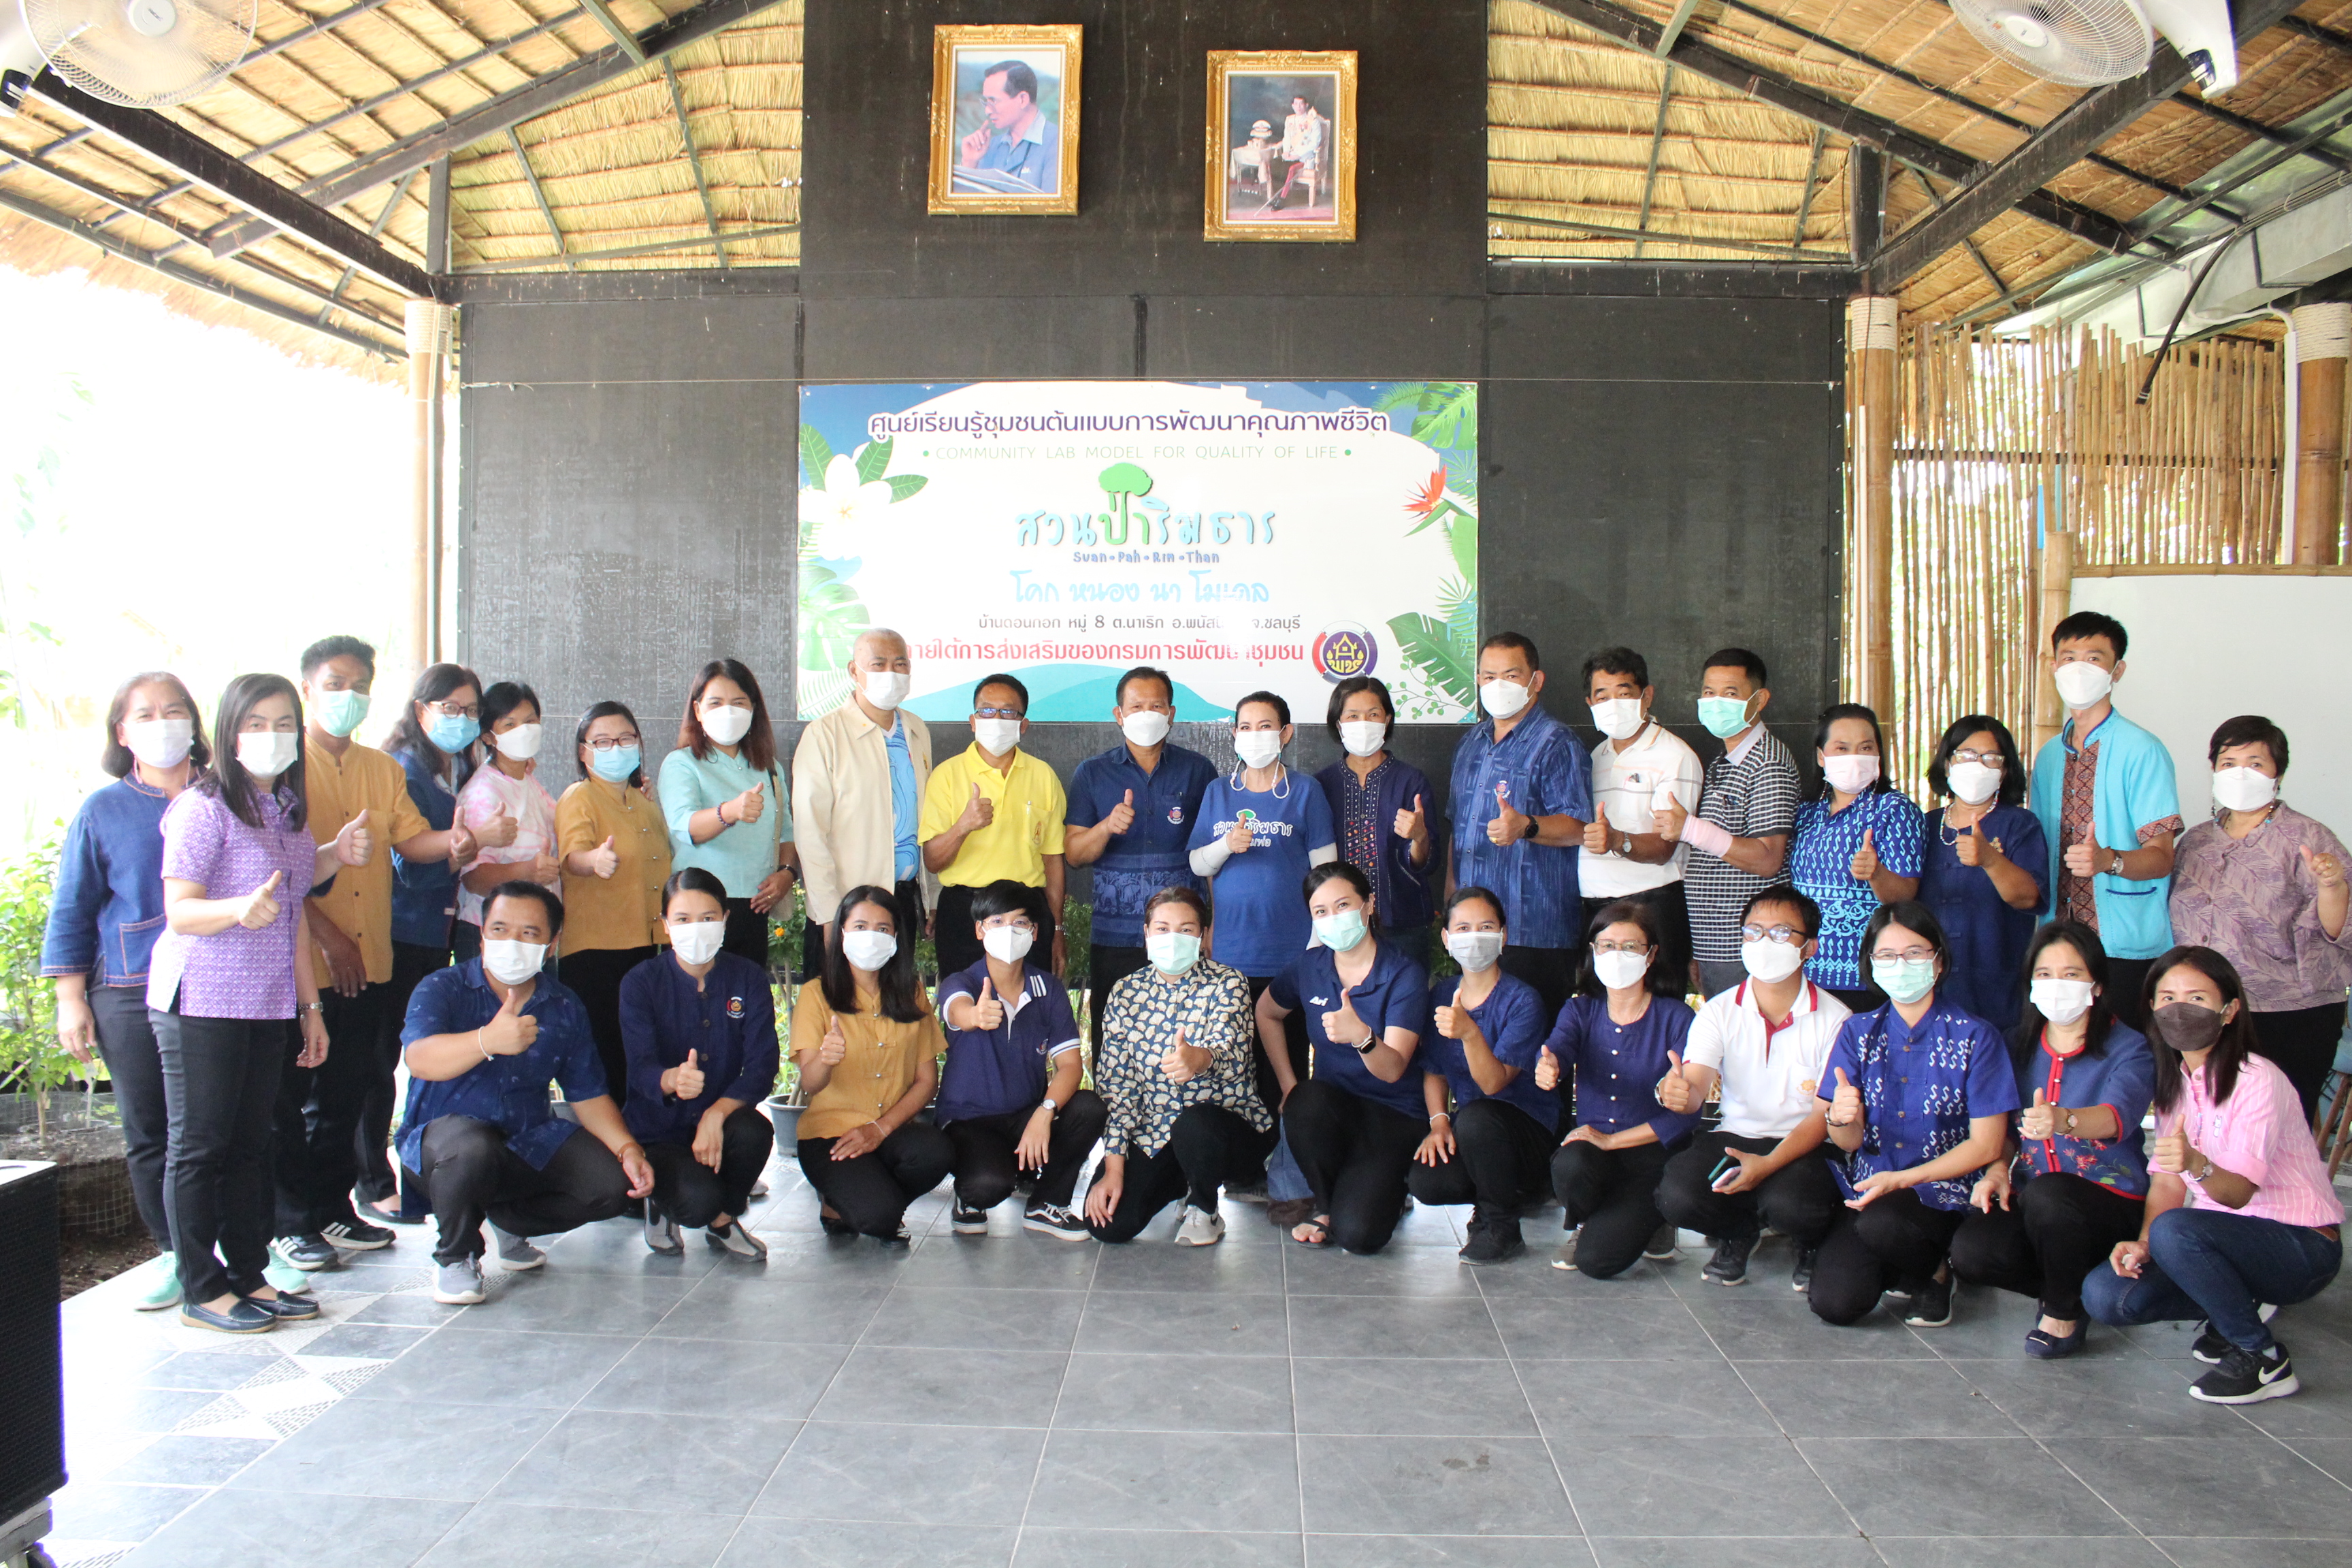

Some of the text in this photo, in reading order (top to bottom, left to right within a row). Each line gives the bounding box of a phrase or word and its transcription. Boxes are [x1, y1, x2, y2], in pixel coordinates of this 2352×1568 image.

[870, 410, 1388, 440] ศูนย์เรียนรู้ชุมชนต้นแบบการพัฒนาคุณภาพชีวิต
[936, 446, 1339, 461] COMMUNITY LAB MODEL FOR QUALITY OF LIFE
[1015, 492, 1276, 547] สวนป่าริมธาร
[1009, 569, 1060, 604] โคก
[1069, 583, 1141, 604] หนอง
[1149, 583, 1182, 604] นา
[1068, 614, 1088, 633] หมู่
[1094, 615, 1106, 629] 8
